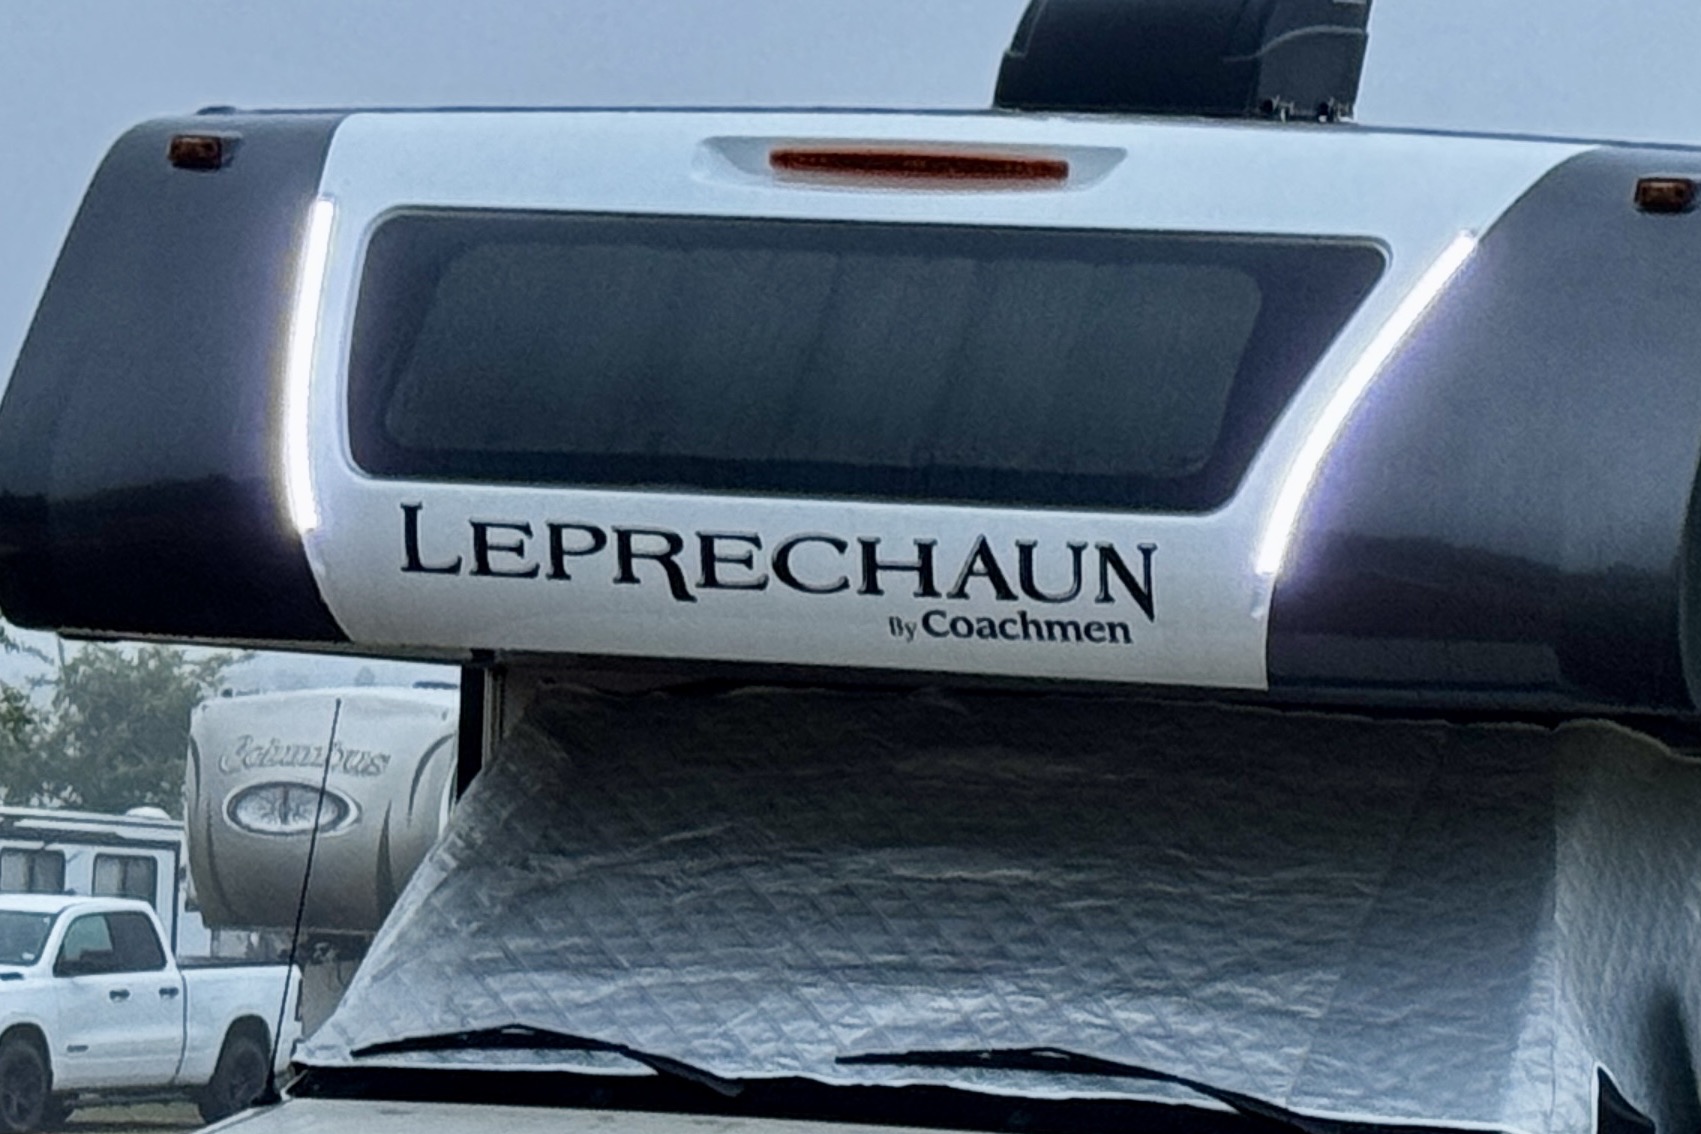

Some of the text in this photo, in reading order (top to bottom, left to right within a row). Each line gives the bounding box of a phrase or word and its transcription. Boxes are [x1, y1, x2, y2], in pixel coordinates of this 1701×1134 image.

[400, 501, 1157, 623] LEPRECHAUN
[888, 609, 1133, 644] By Coachmen
